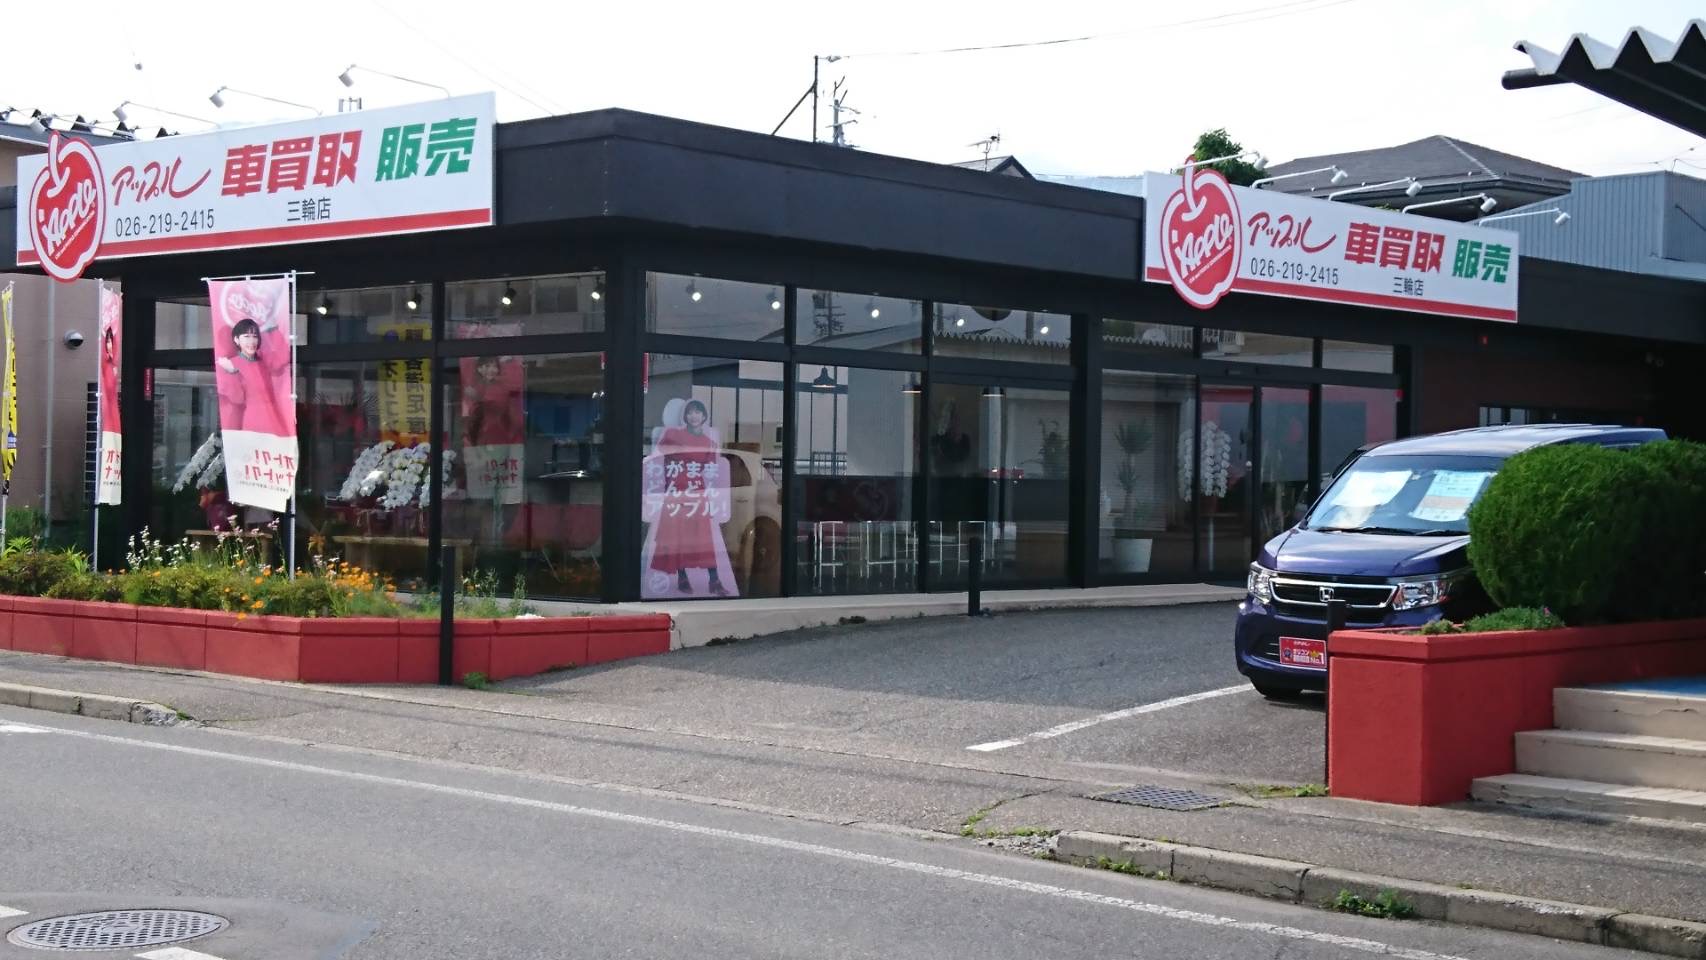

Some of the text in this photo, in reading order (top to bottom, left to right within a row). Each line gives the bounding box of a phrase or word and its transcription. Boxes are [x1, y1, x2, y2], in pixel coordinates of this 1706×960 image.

[111, 117, 478, 207] アップル 車買取 販売
[115, 209, 215, 238] 026-219-2415
[286, 198, 332, 222] 三輪店
[1247, 212, 1512, 284] アップル 車買取 販売
[1250, 257, 1339, 286] 026-219-2415
[1392, 276, 1424, 297] 三輪店
[646, 461, 720, 479] わがまま
[646, 480, 720, 498] どんどん
